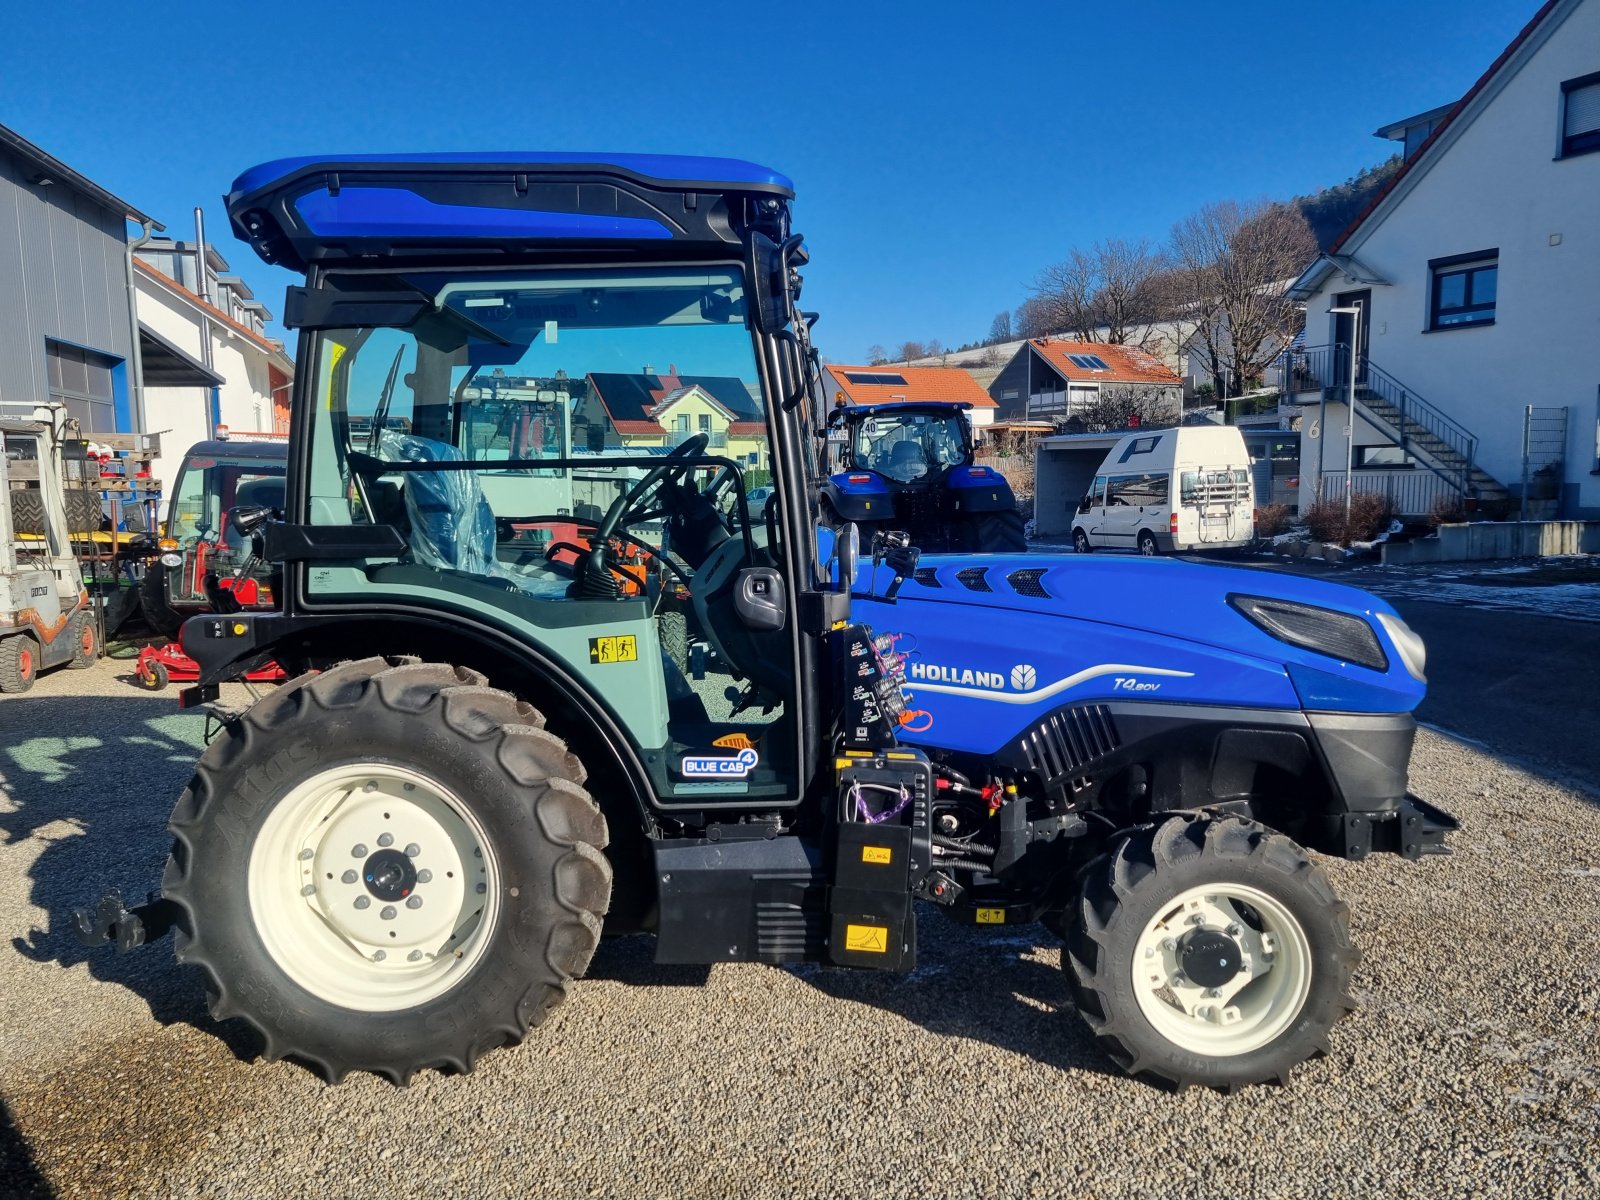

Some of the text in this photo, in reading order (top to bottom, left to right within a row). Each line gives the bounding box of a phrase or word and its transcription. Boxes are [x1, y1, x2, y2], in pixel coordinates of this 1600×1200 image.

[865, 422, 876, 433] 40
[1308, 419, 1320, 439] 6
[31, 586, 48, 598] FIAT
[911, 662, 1005, 689] HOLLAND
[1113, 677, 1161, 691] T4.80V
[686, 752, 754, 773] BLUE CAB 4
